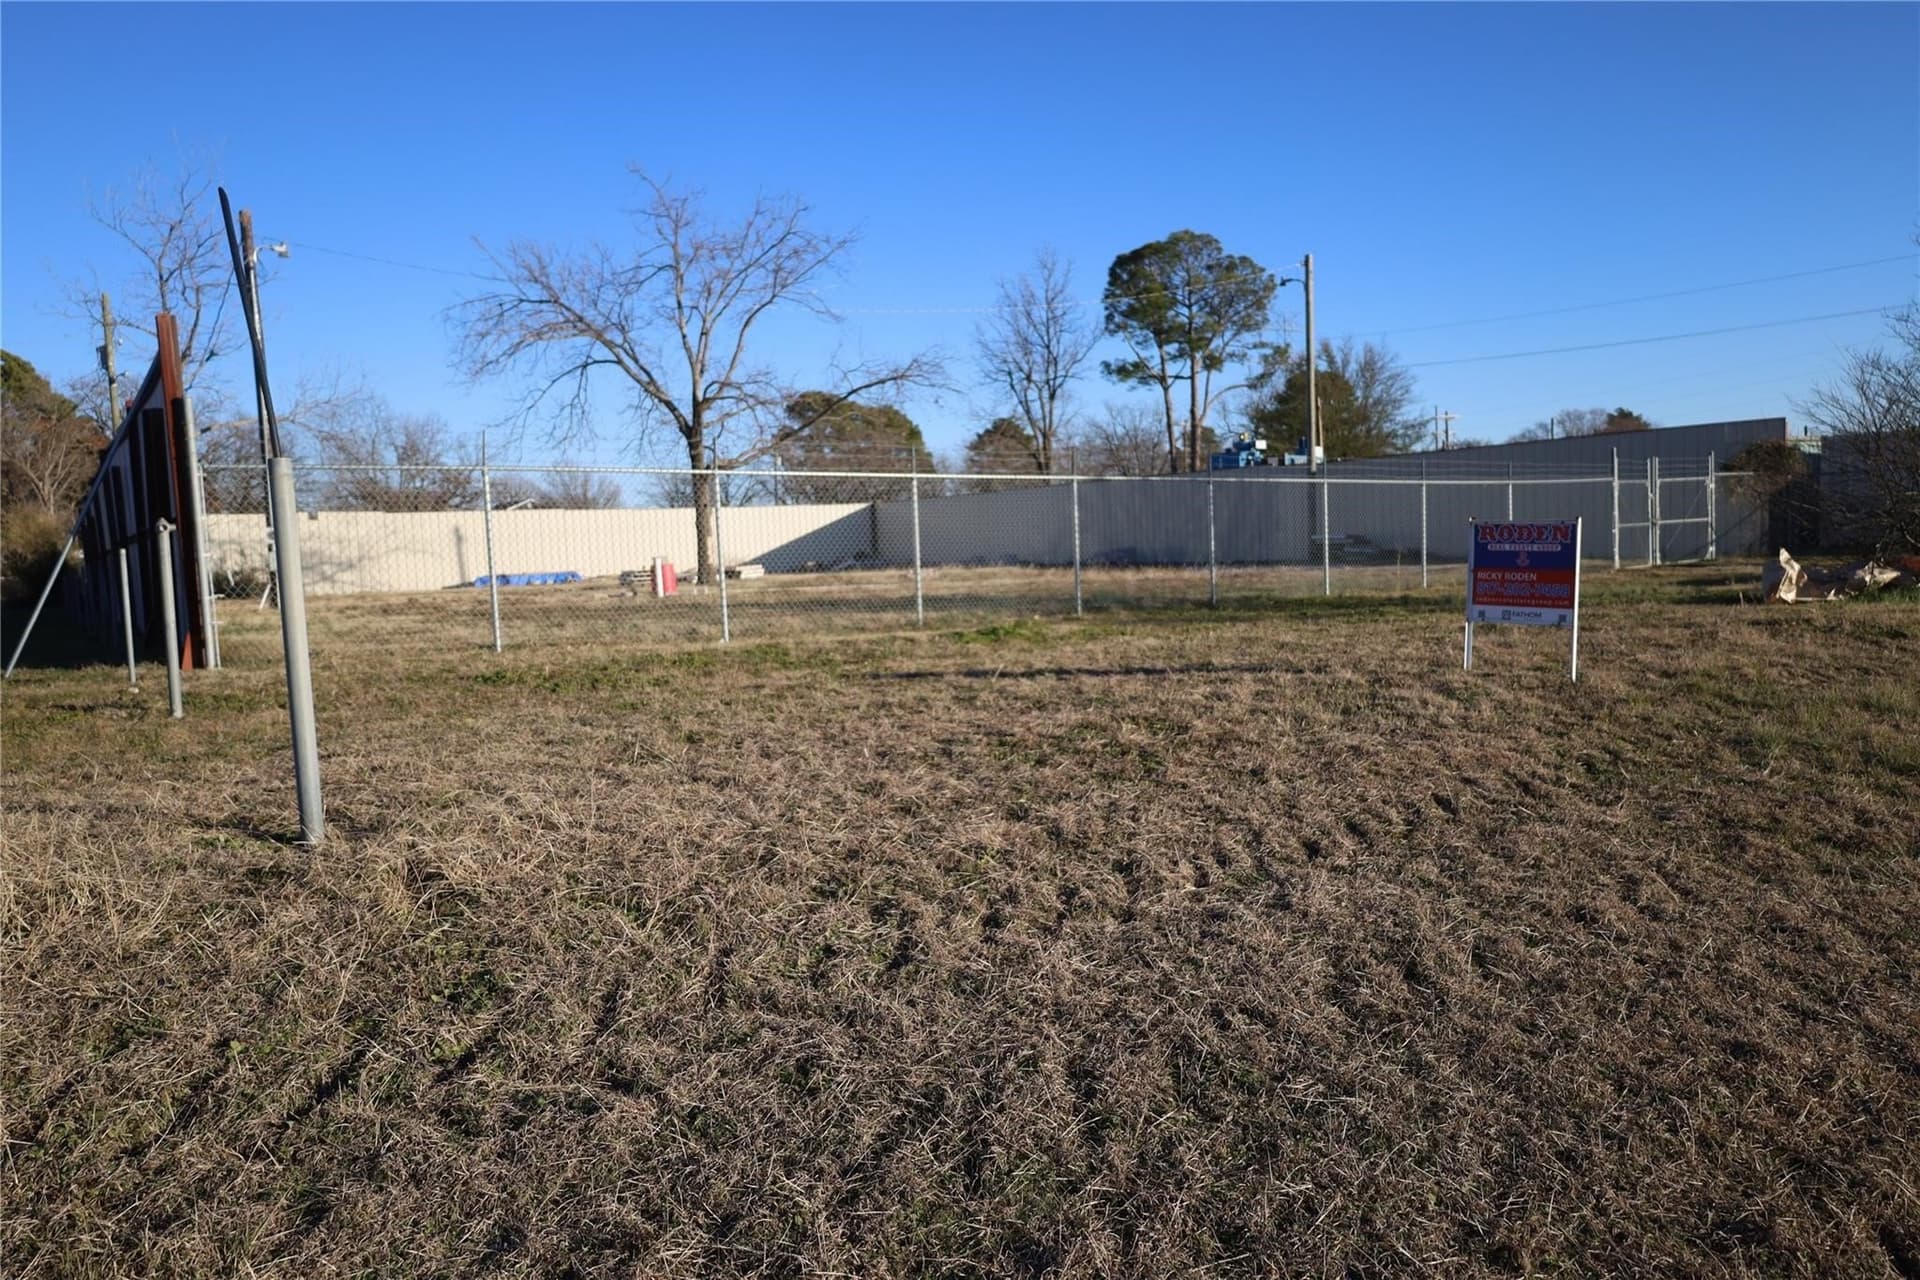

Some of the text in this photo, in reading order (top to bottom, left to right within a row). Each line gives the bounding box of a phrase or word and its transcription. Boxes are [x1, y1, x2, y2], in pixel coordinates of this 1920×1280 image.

[1479, 524, 1571, 543] RODEN
[1477, 571, 1536, 581] RICKY RODEN
[1512, 610, 1542, 618] FATHOM
